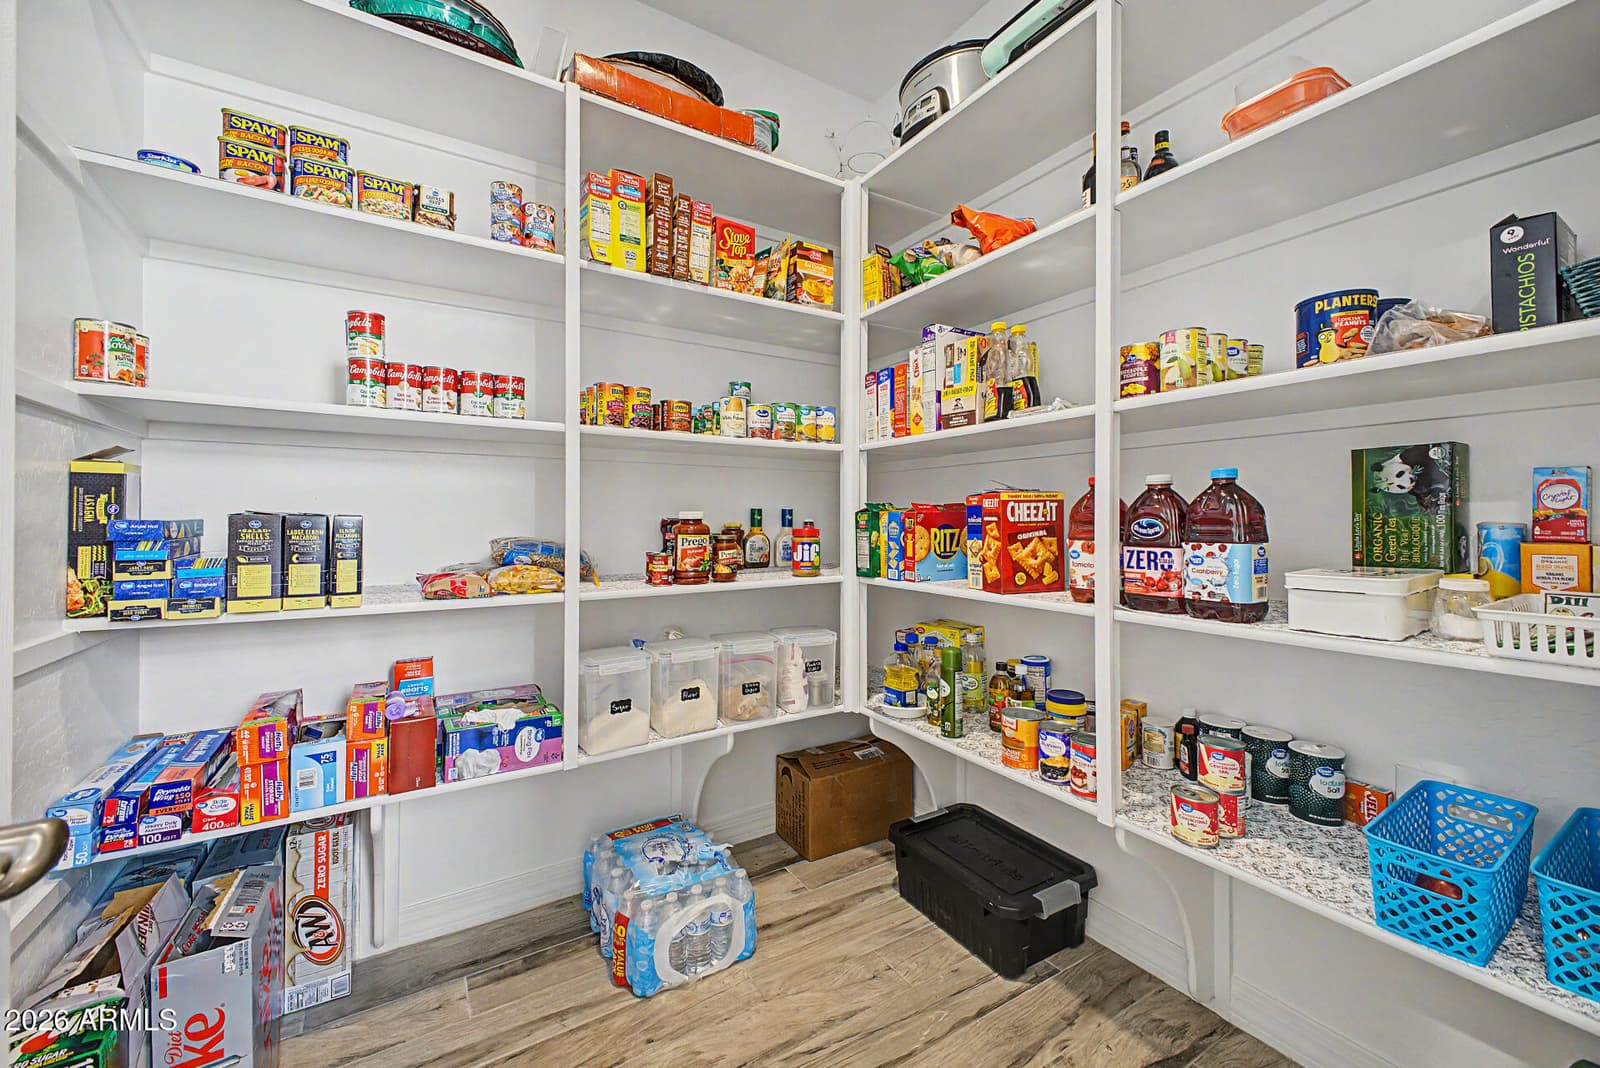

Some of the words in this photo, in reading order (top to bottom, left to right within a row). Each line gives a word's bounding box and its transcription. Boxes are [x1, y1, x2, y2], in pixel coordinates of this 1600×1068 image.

[230, 115, 277, 138] SPAM
[240, 132, 270, 144] BACON
[296, 131, 339, 150] SPAM
[226, 143, 274, 165] SPAM
[237, 161, 268, 172] BACON
[303, 161, 347, 182] SPAM
[363, 176, 404, 195] SPAM
[719, 227, 751, 250] Stove
[1502, 237, 1551, 254] Wonderful
[731, 243, 747, 257] Top
[1315, 294, 1377, 314] PLANTERS
[1543, 489, 1571, 502] Crystal
[1555, 495, 1575, 503] Light
[1006, 501, 1058, 522] CHEEZ-IT
[1017, 529, 1047, 540] ORIGINAL
[1385, 517, 1397, 534] Tea
[681, 537, 708, 547] Prego
[930, 527, 960, 554] RITZ
[1372, 512, 1383, 562] ORGANIC
[793, 543, 820, 562] Jif
[1385, 536, 1397, 562] Green
[1126, 549, 1173, 571] ZERO
[1192, 567, 1224, 576] Cranberry
[320, 753, 330, 764] 75
[275, 780, 284, 800] Hefty
[201, 820, 224, 831] 400
[142, 834, 161, 844] 100
[75, 852, 88, 865] 50
[317, 834, 326, 864] SUGAR
[317, 865, 326, 890] ZERO
[296, 911, 339, 950] A&W
[616, 949, 625, 977] VALUE
[30, 1048, 68, 1065] SUGAR
[163, 1031, 182, 1064] Diet
